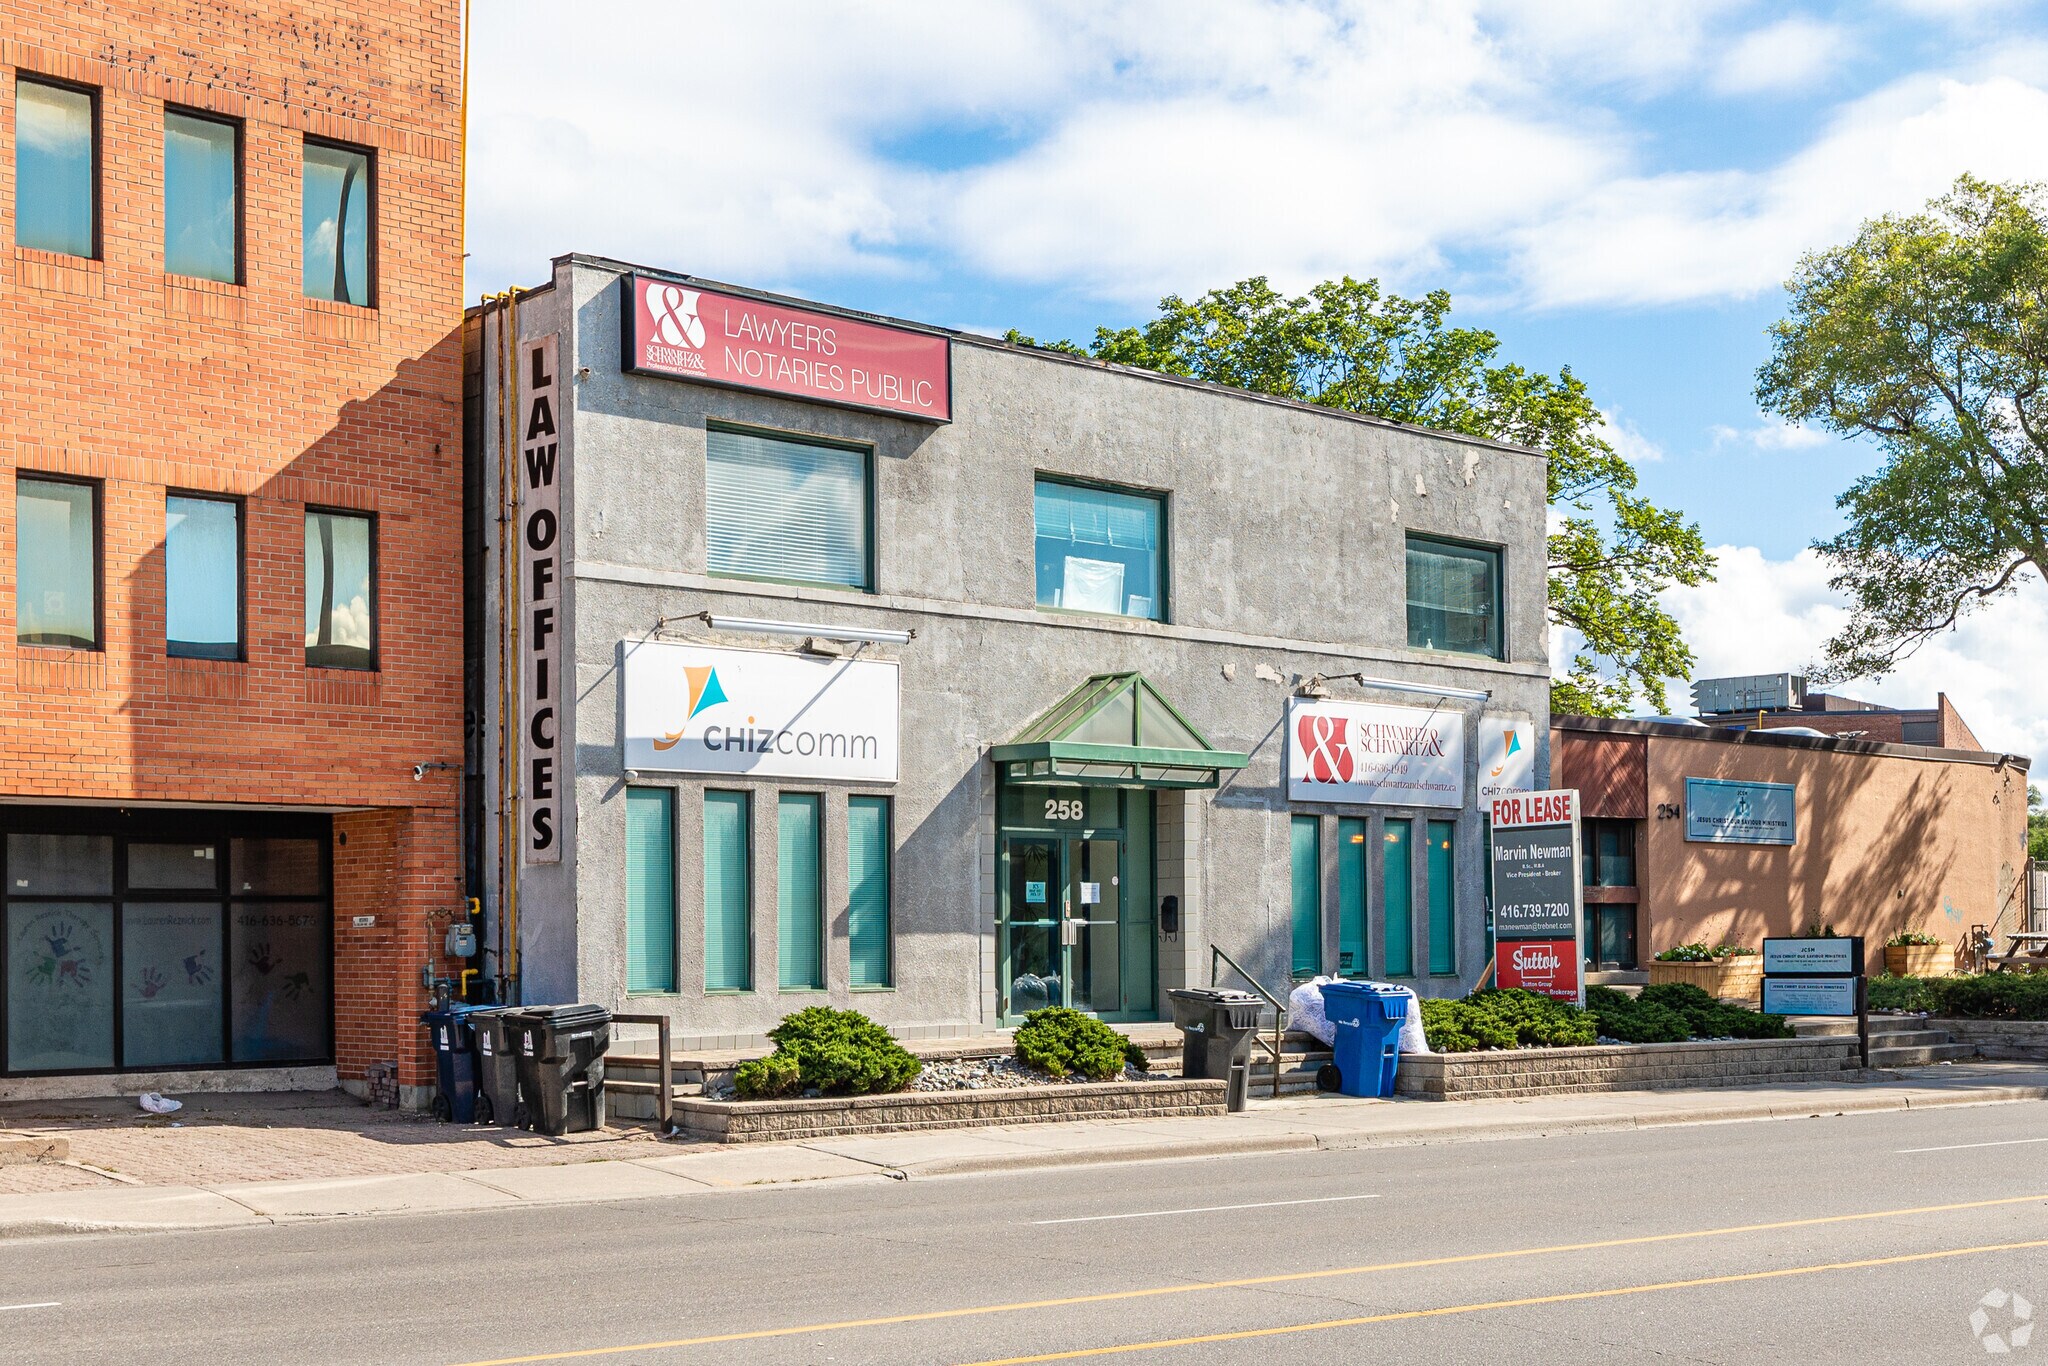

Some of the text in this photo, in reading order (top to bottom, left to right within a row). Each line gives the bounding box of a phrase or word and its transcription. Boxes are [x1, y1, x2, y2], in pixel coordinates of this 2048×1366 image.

[724, 309, 838, 356] LAWYERS
[646, 361, 708, 377] Professional Corporation
[724, 345, 933, 408] NOTARIES PUBLIC
[525, 347, 557, 851] LAW OFFICES
[1360, 762, 1408, 775] 416-636-1949
[1357, 779, 1457, 792] www.schwartzandschwartz.ca
[1044, 799, 1084, 821] 258
[1492, 795, 1572, 825] FOR LEASE
[1656, 803, 1680, 820] 254
[1495, 843, 1572, 861] Marvin Newman
[1500, 902, 1570, 919] 416.739.7200
[1512, 949, 1561, 971] Sutton
[1550, 989, 1577, 997] Brokerage
